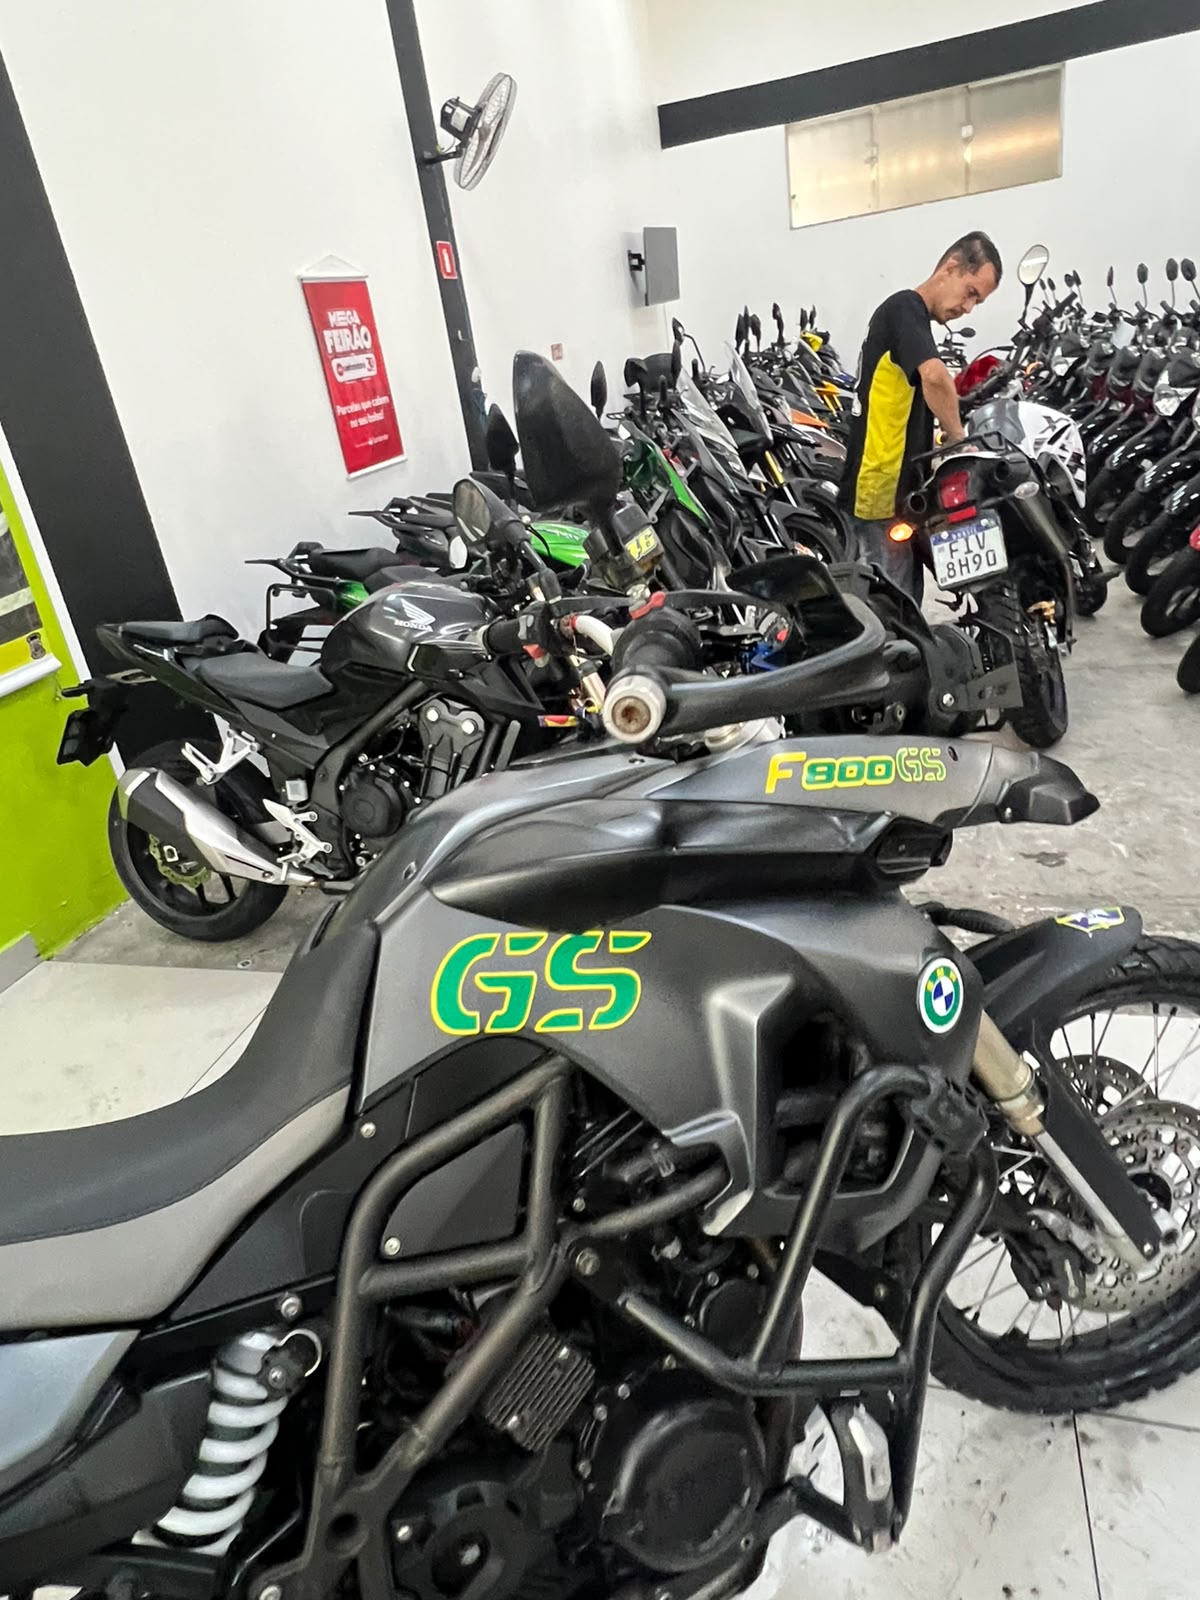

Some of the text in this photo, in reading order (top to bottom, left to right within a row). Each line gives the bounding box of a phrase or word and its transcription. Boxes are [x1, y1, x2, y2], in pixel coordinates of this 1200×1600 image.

[327, 310, 361, 328] MEGA
[948, 532, 986, 559] FIV
[946, 549, 998, 579] 8H90
[394, 619, 434, 633] HONDA
[430, 930, 652, 1035] GS
